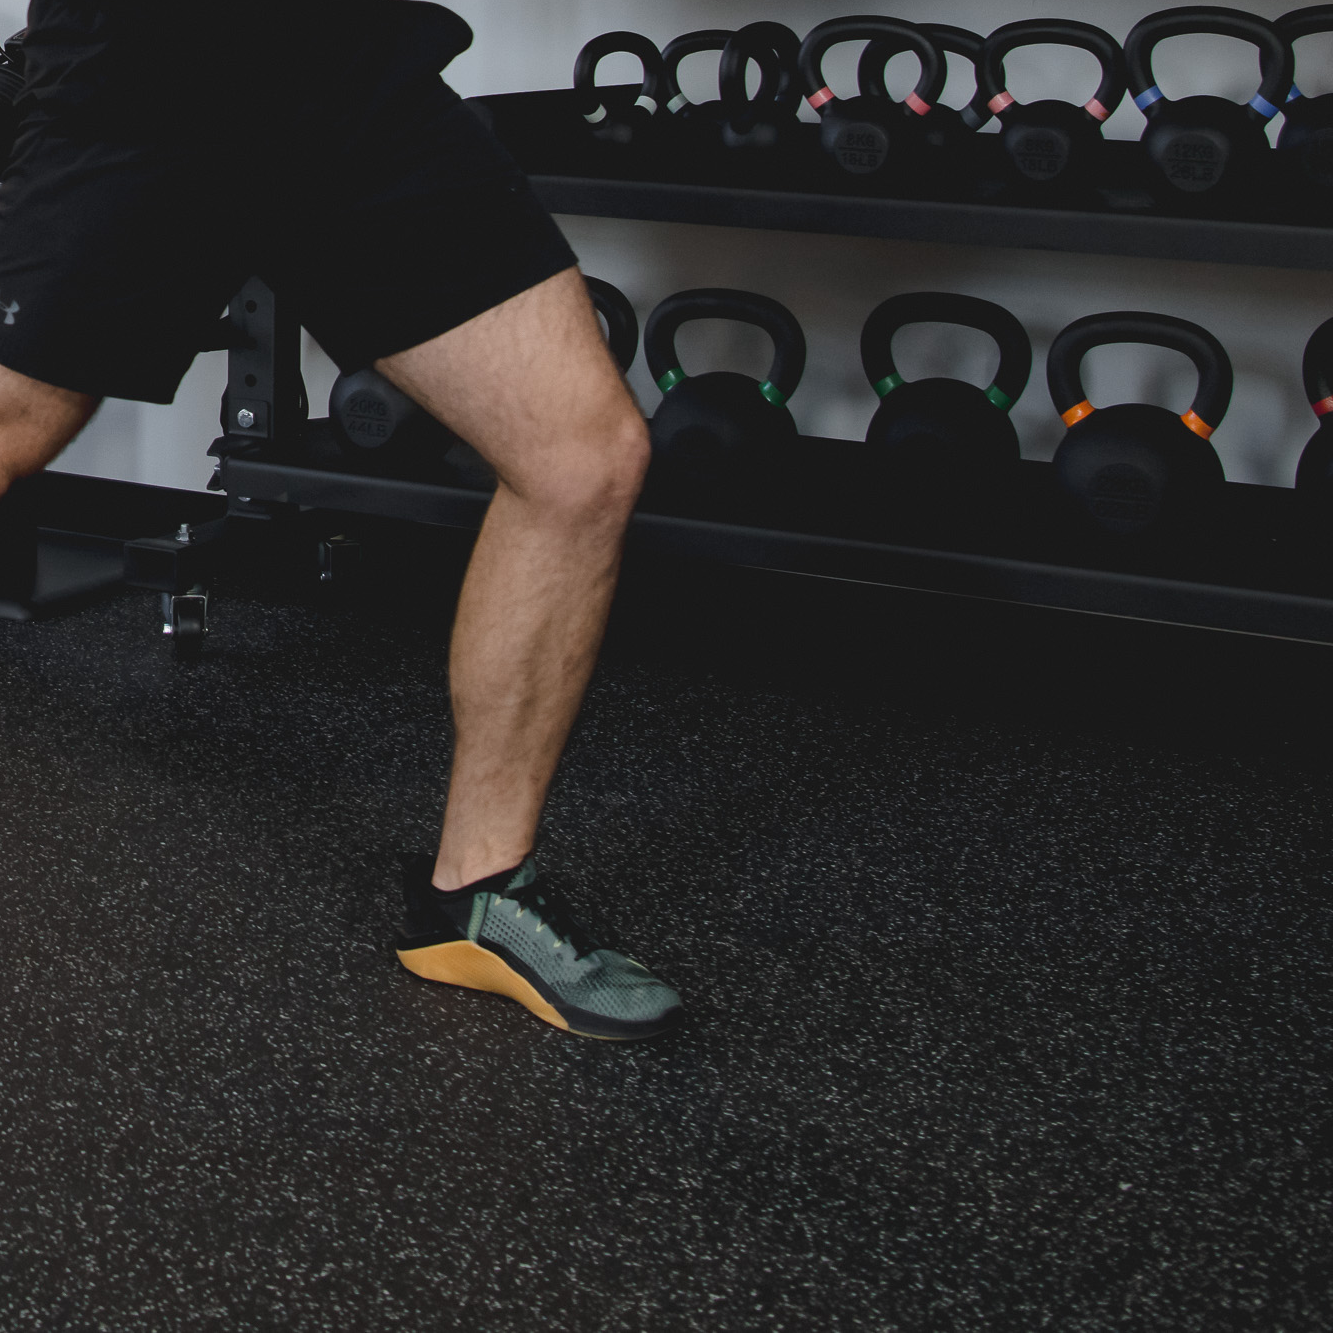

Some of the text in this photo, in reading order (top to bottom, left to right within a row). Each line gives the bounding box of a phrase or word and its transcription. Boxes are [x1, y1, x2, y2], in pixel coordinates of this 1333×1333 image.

[1173, 143, 1213, 159] 12KG
[350, 397, 387, 416] 20KG
[348, 420, 387, 437] 44LB
